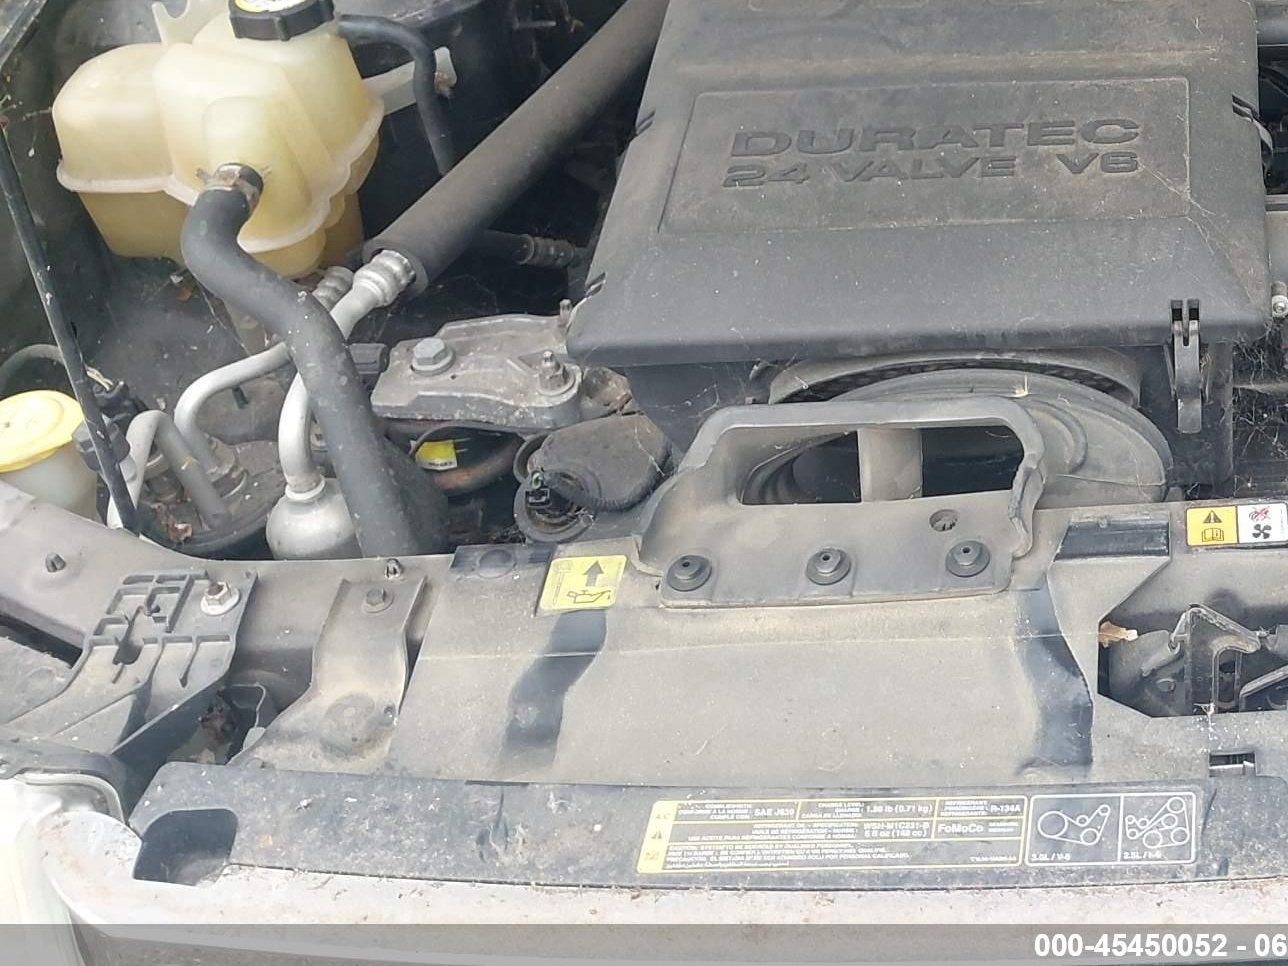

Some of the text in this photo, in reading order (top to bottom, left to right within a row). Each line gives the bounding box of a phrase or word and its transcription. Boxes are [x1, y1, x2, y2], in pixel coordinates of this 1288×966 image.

[730, 119, 1140, 158] DURATEC
[722, 150, 1140, 188] 24 VALVE V6
[918, 804, 933, 813] kg)
[990, 804, 1021, 813] R-134A
[938, 824, 984, 833] FoMoCo
